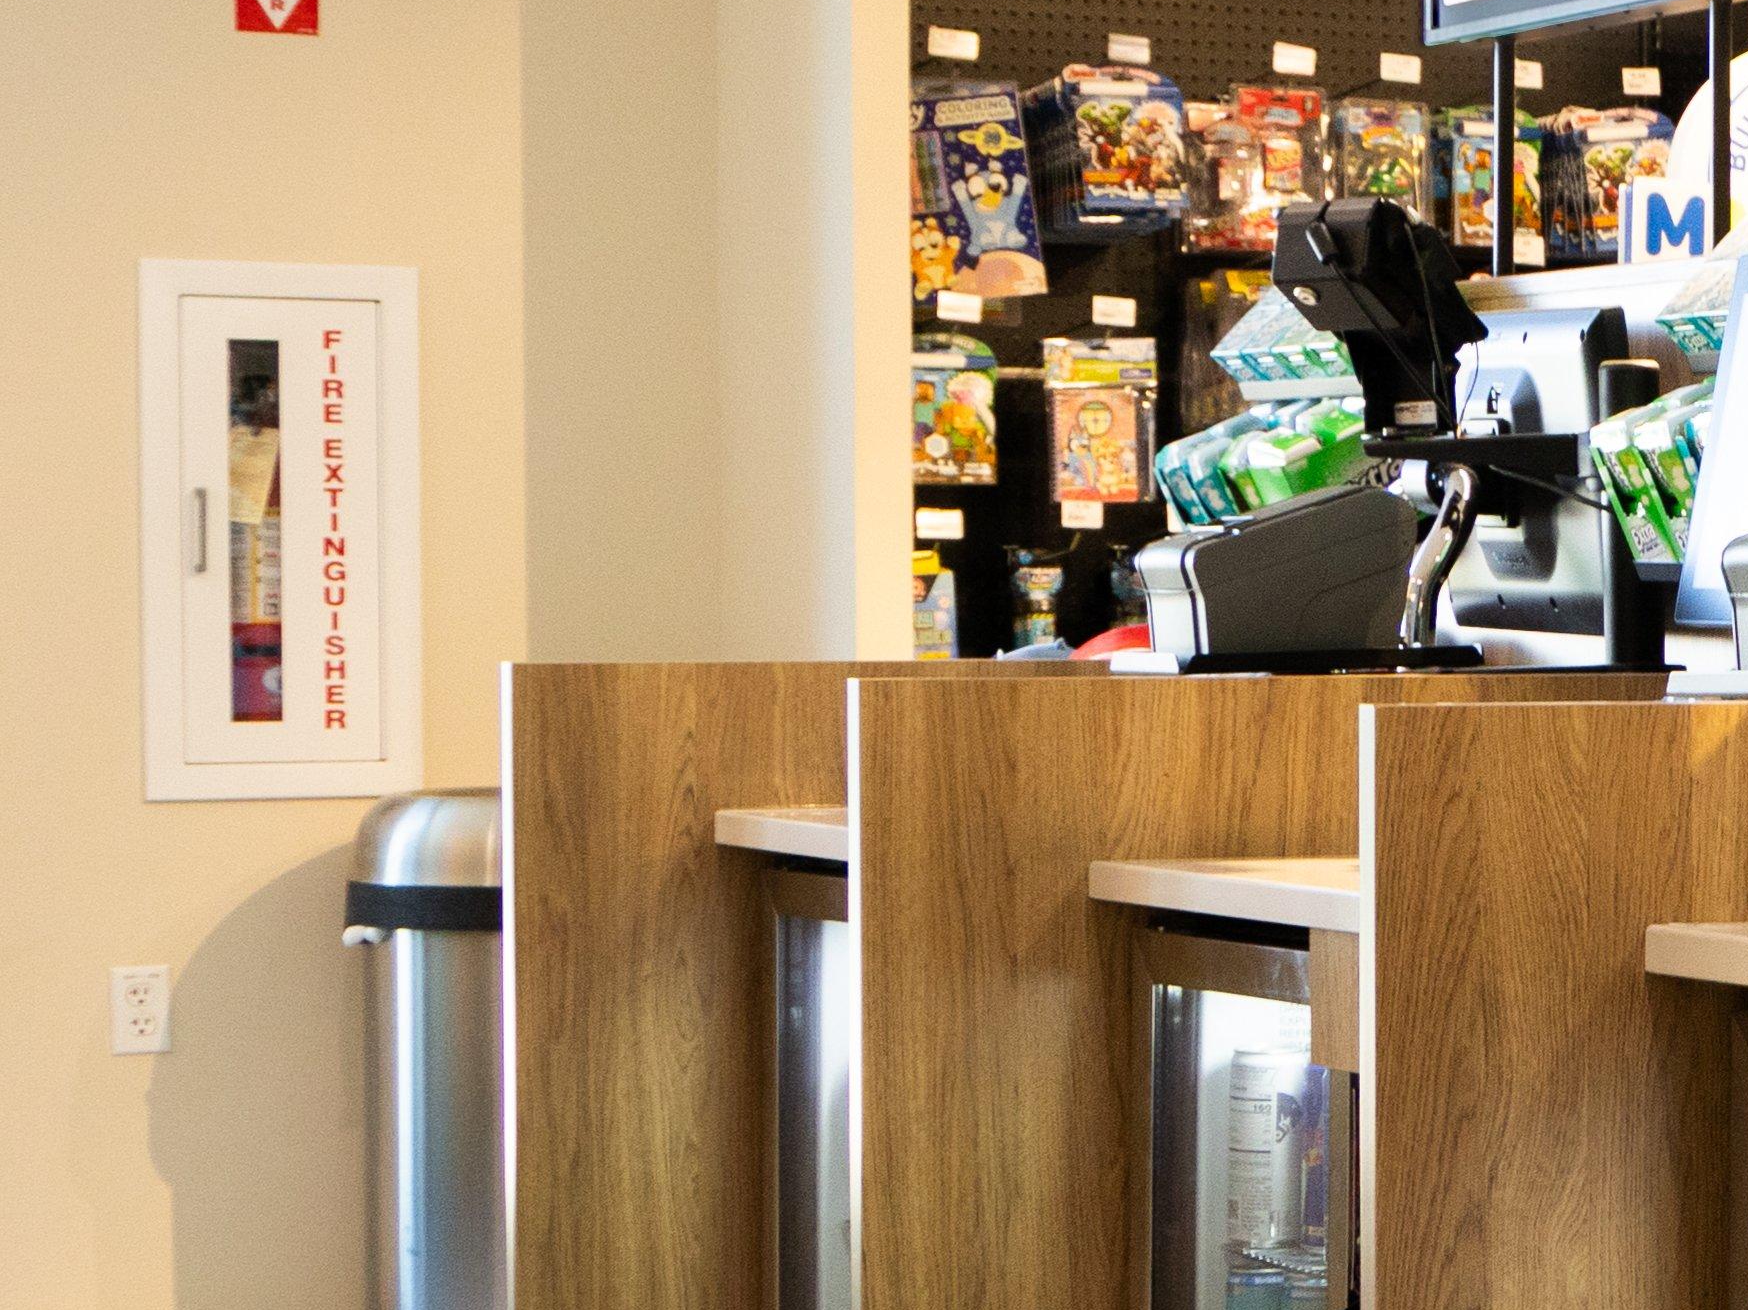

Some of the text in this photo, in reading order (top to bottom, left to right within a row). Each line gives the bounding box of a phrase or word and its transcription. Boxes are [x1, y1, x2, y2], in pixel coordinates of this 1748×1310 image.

[938, 97, 1008, 115] COLORING
[1646, 192, 1705, 256] M
[323, 330, 347, 729] FIRE EXTINGUISHER
